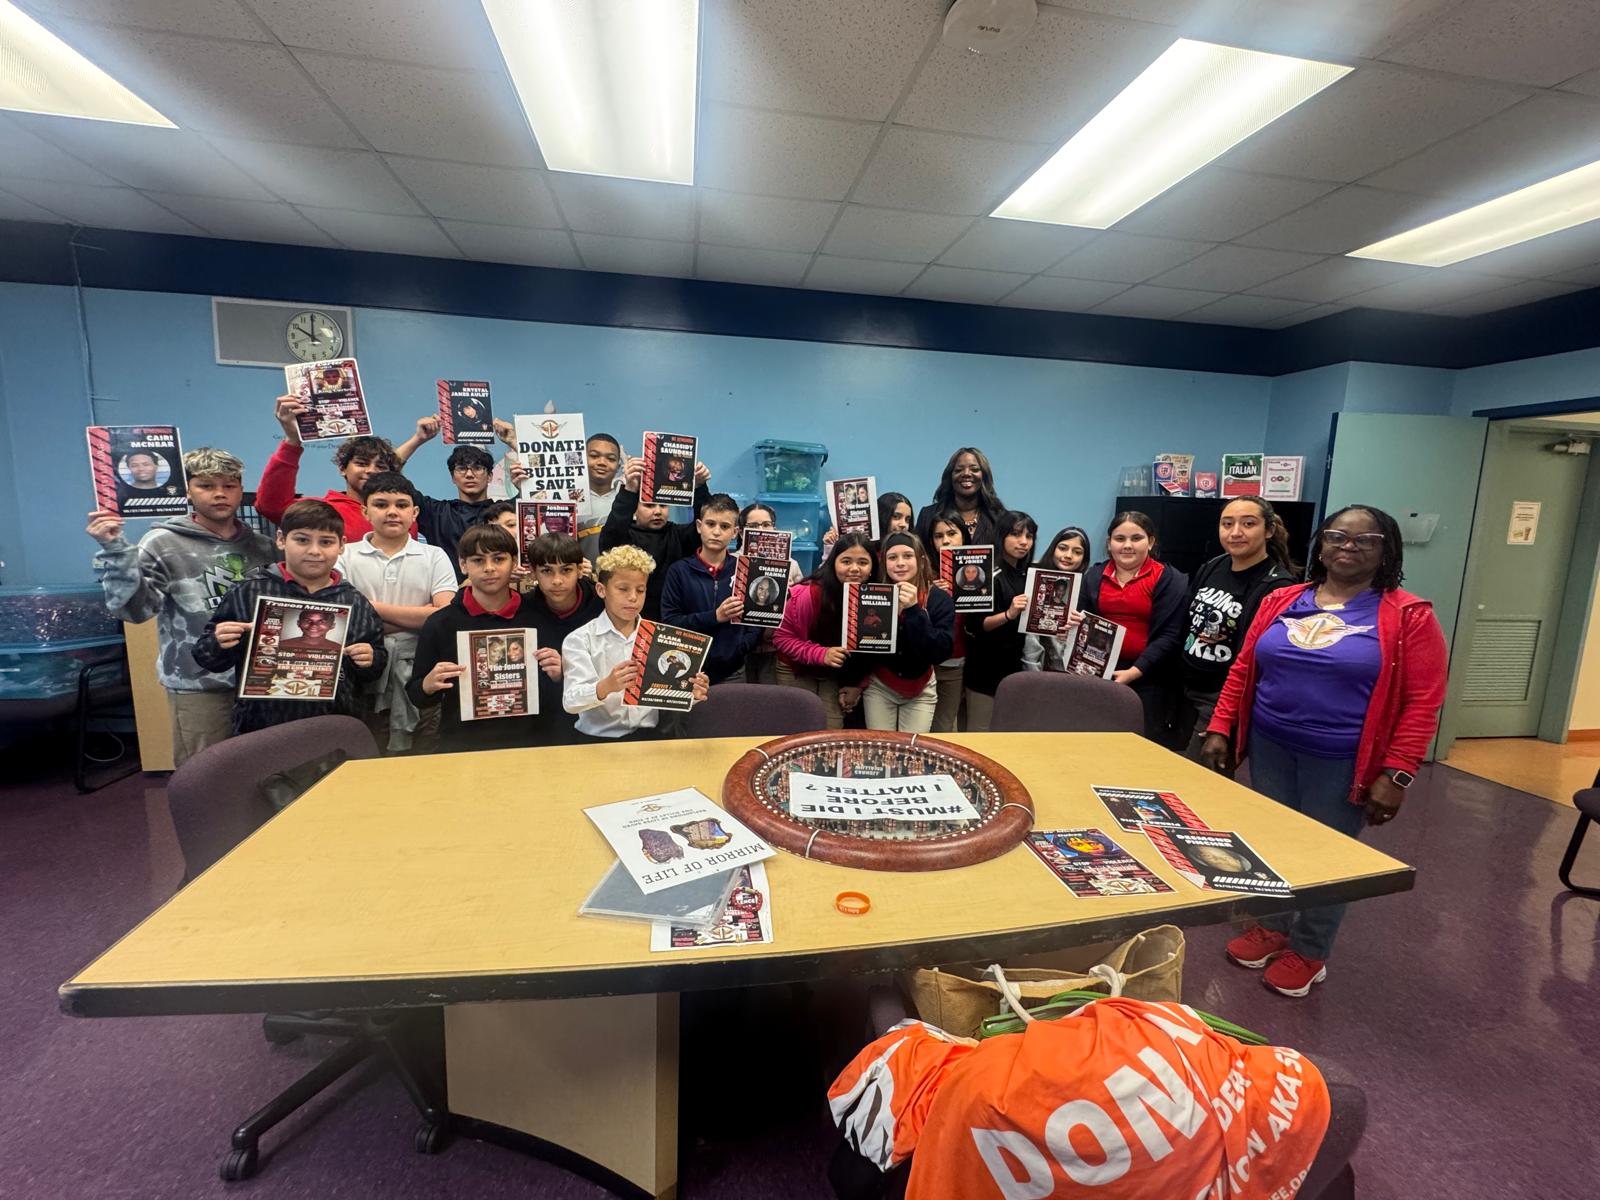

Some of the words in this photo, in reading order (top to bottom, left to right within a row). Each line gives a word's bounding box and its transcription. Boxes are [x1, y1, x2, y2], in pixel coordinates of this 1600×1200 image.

[519, 440, 584, 453] DONATE
[661, 448, 693, 456] SAUNDERS
[548, 454, 559, 465] A
[522, 466, 585, 478] BULLET
[1229, 465, 1257, 474] ITALIAN
[536, 479, 576, 490] SAVE
[552, 492, 562, 500] A
[1195, 587, 1243, 618] EADING
[658, 634, 681, 642] ALANA
[657, 639, 703, 652] WASHINGTON
[826, 785, 926, 795] MATTER
[826, 795, 929, 805] BEFORE
[801, 804, 844, 814] DIE
[856, 806, 862, 814] I
[872, 805, 963, 816] #MUST
[1176, 834, 1232, 843] DESMOND
[704, 842, 765, 865] MIRROR
[684, 861, 702, 874] OF
[642, 867, 678, 885] LIFE
[1268, 1072, 1302, 1143] AKA
